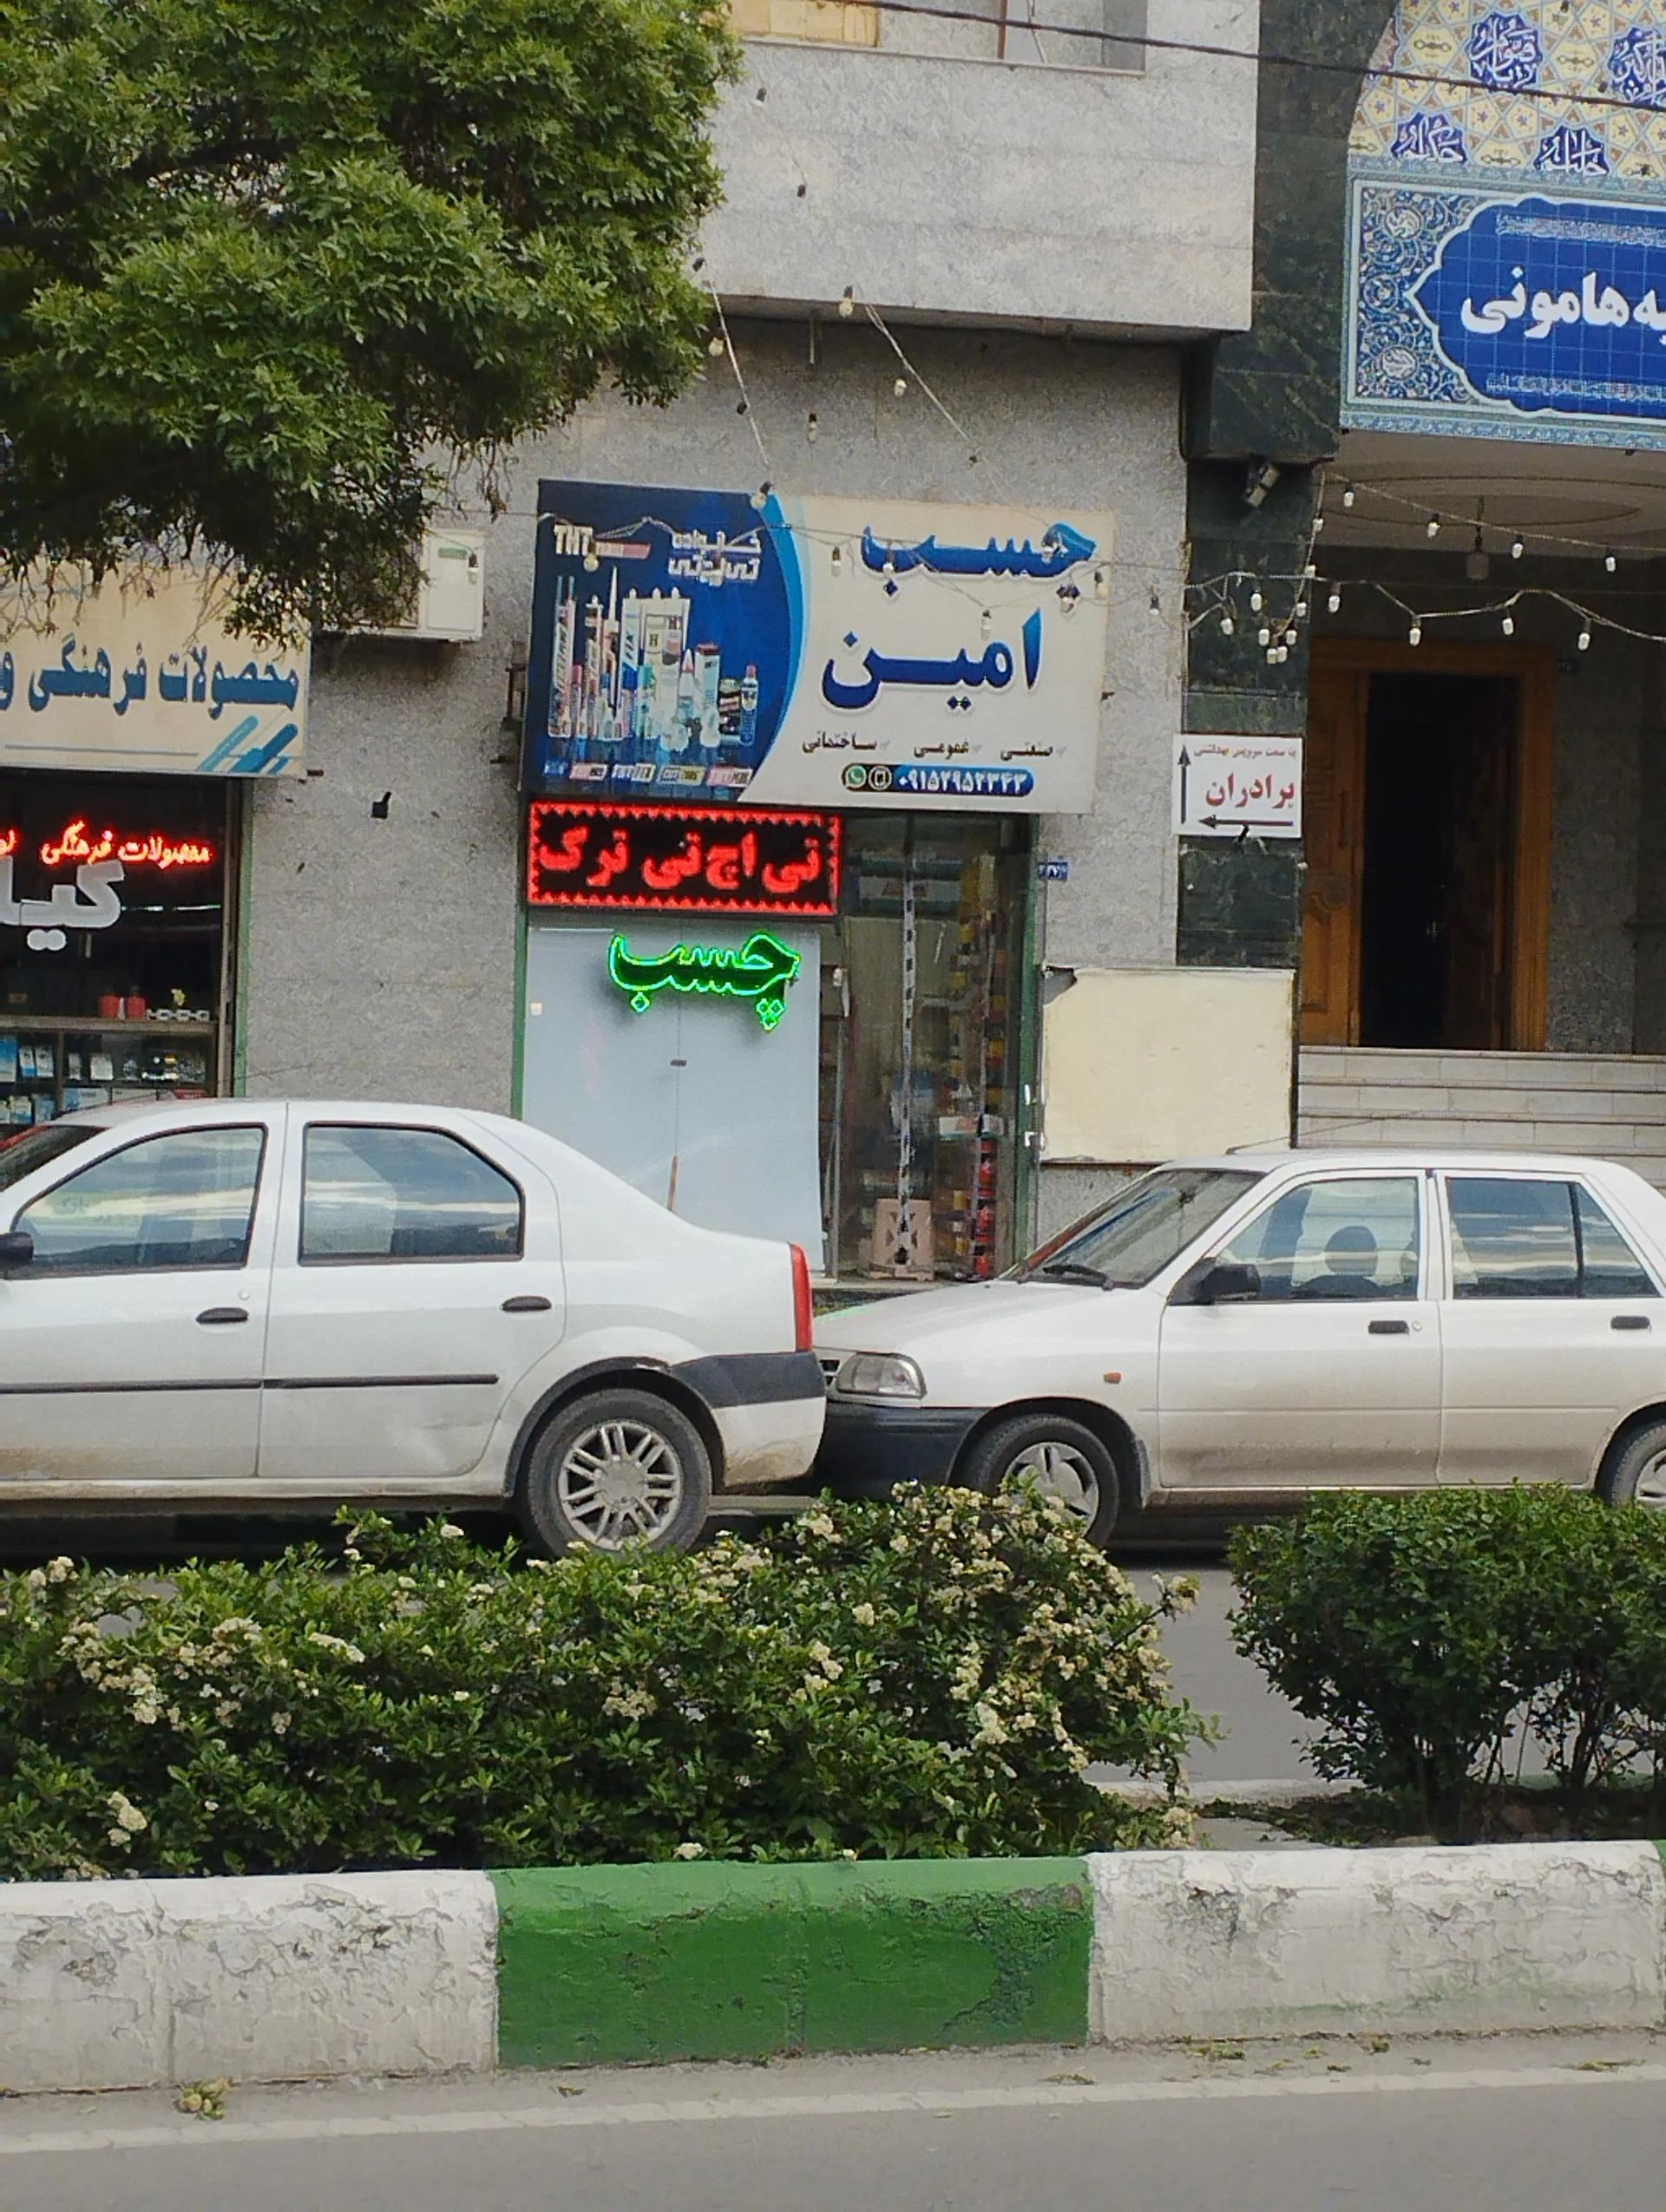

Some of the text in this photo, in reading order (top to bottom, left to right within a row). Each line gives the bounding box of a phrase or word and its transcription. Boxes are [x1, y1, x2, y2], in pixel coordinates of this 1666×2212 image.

[554, 524, 594, 555] THT
[29, 632, 148, 717] فرهنگی
[159, 645, 299, 721] محصولات
[822, 607, 1041, 710] امین
[1205, 770, 1295, 810] برادران
[609, 930, 802, 1031] چسب
